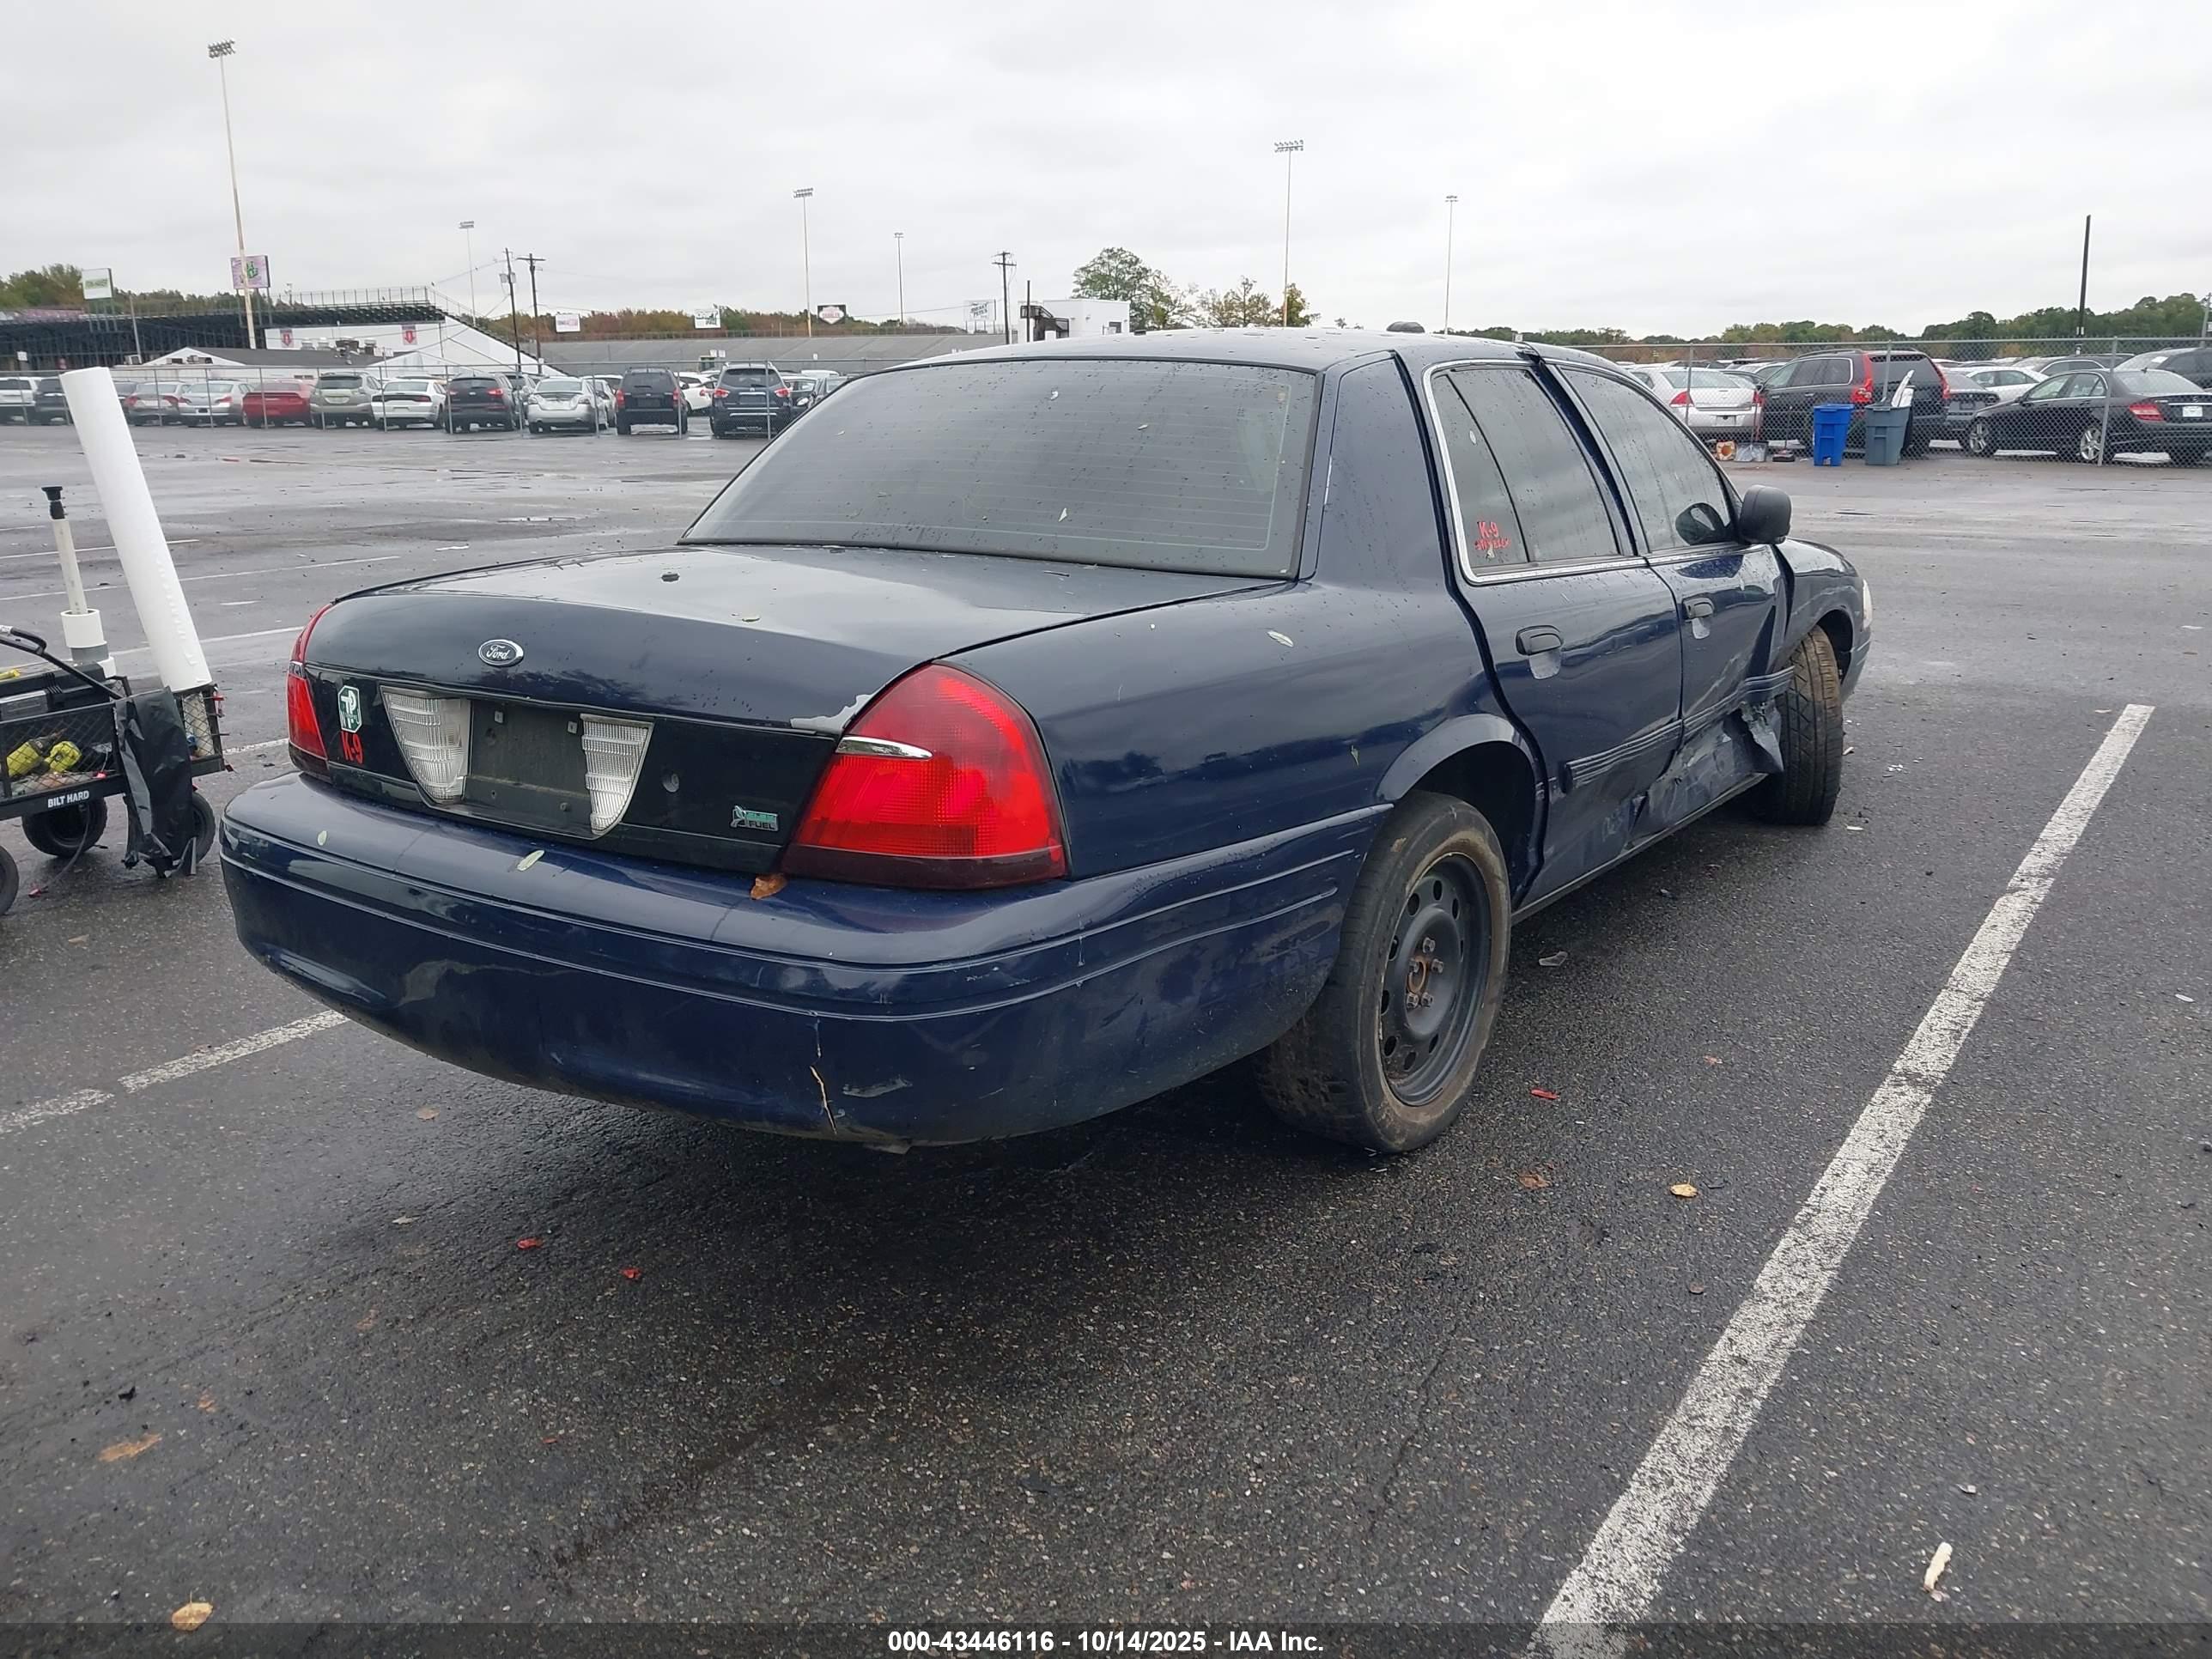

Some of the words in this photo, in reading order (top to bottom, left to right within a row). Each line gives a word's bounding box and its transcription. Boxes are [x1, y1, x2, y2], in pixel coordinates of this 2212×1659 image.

[1479, 521, 1499, 538] K-9
[486, 644, 511, 659] Ford
[341, 731, 363, 764] K-9
[47, 795, 66, 808] BILT
[67, 790, 89, 804] HARD
[749, 821, 775, 830] FUEL
